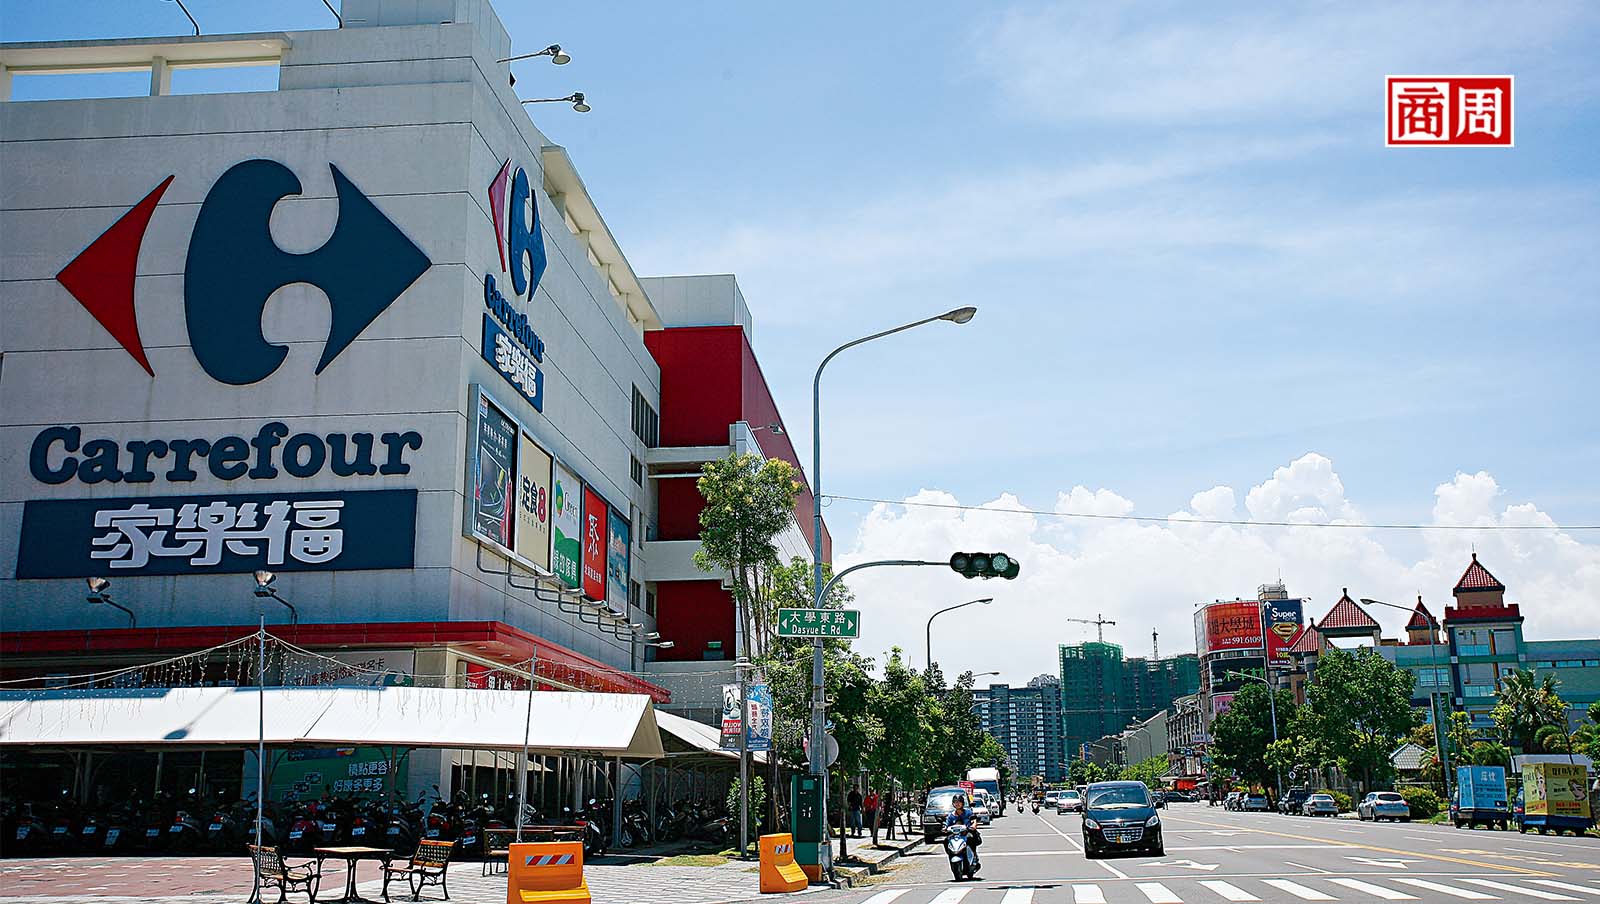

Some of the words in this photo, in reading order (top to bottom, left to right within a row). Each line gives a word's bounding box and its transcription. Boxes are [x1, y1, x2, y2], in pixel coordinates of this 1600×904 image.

[484, 274, 546, 364] Carrefour
[495, 333, 537, 398] 家樂福
[29, 421, 423, 485] Carrefour
[90, 500, 345, 568] 家樂福
[789, 611, 845, 624] 大學東路
[791, 624, 819, 635] Dasyue
[1271, 607, 1297, 620] Super
